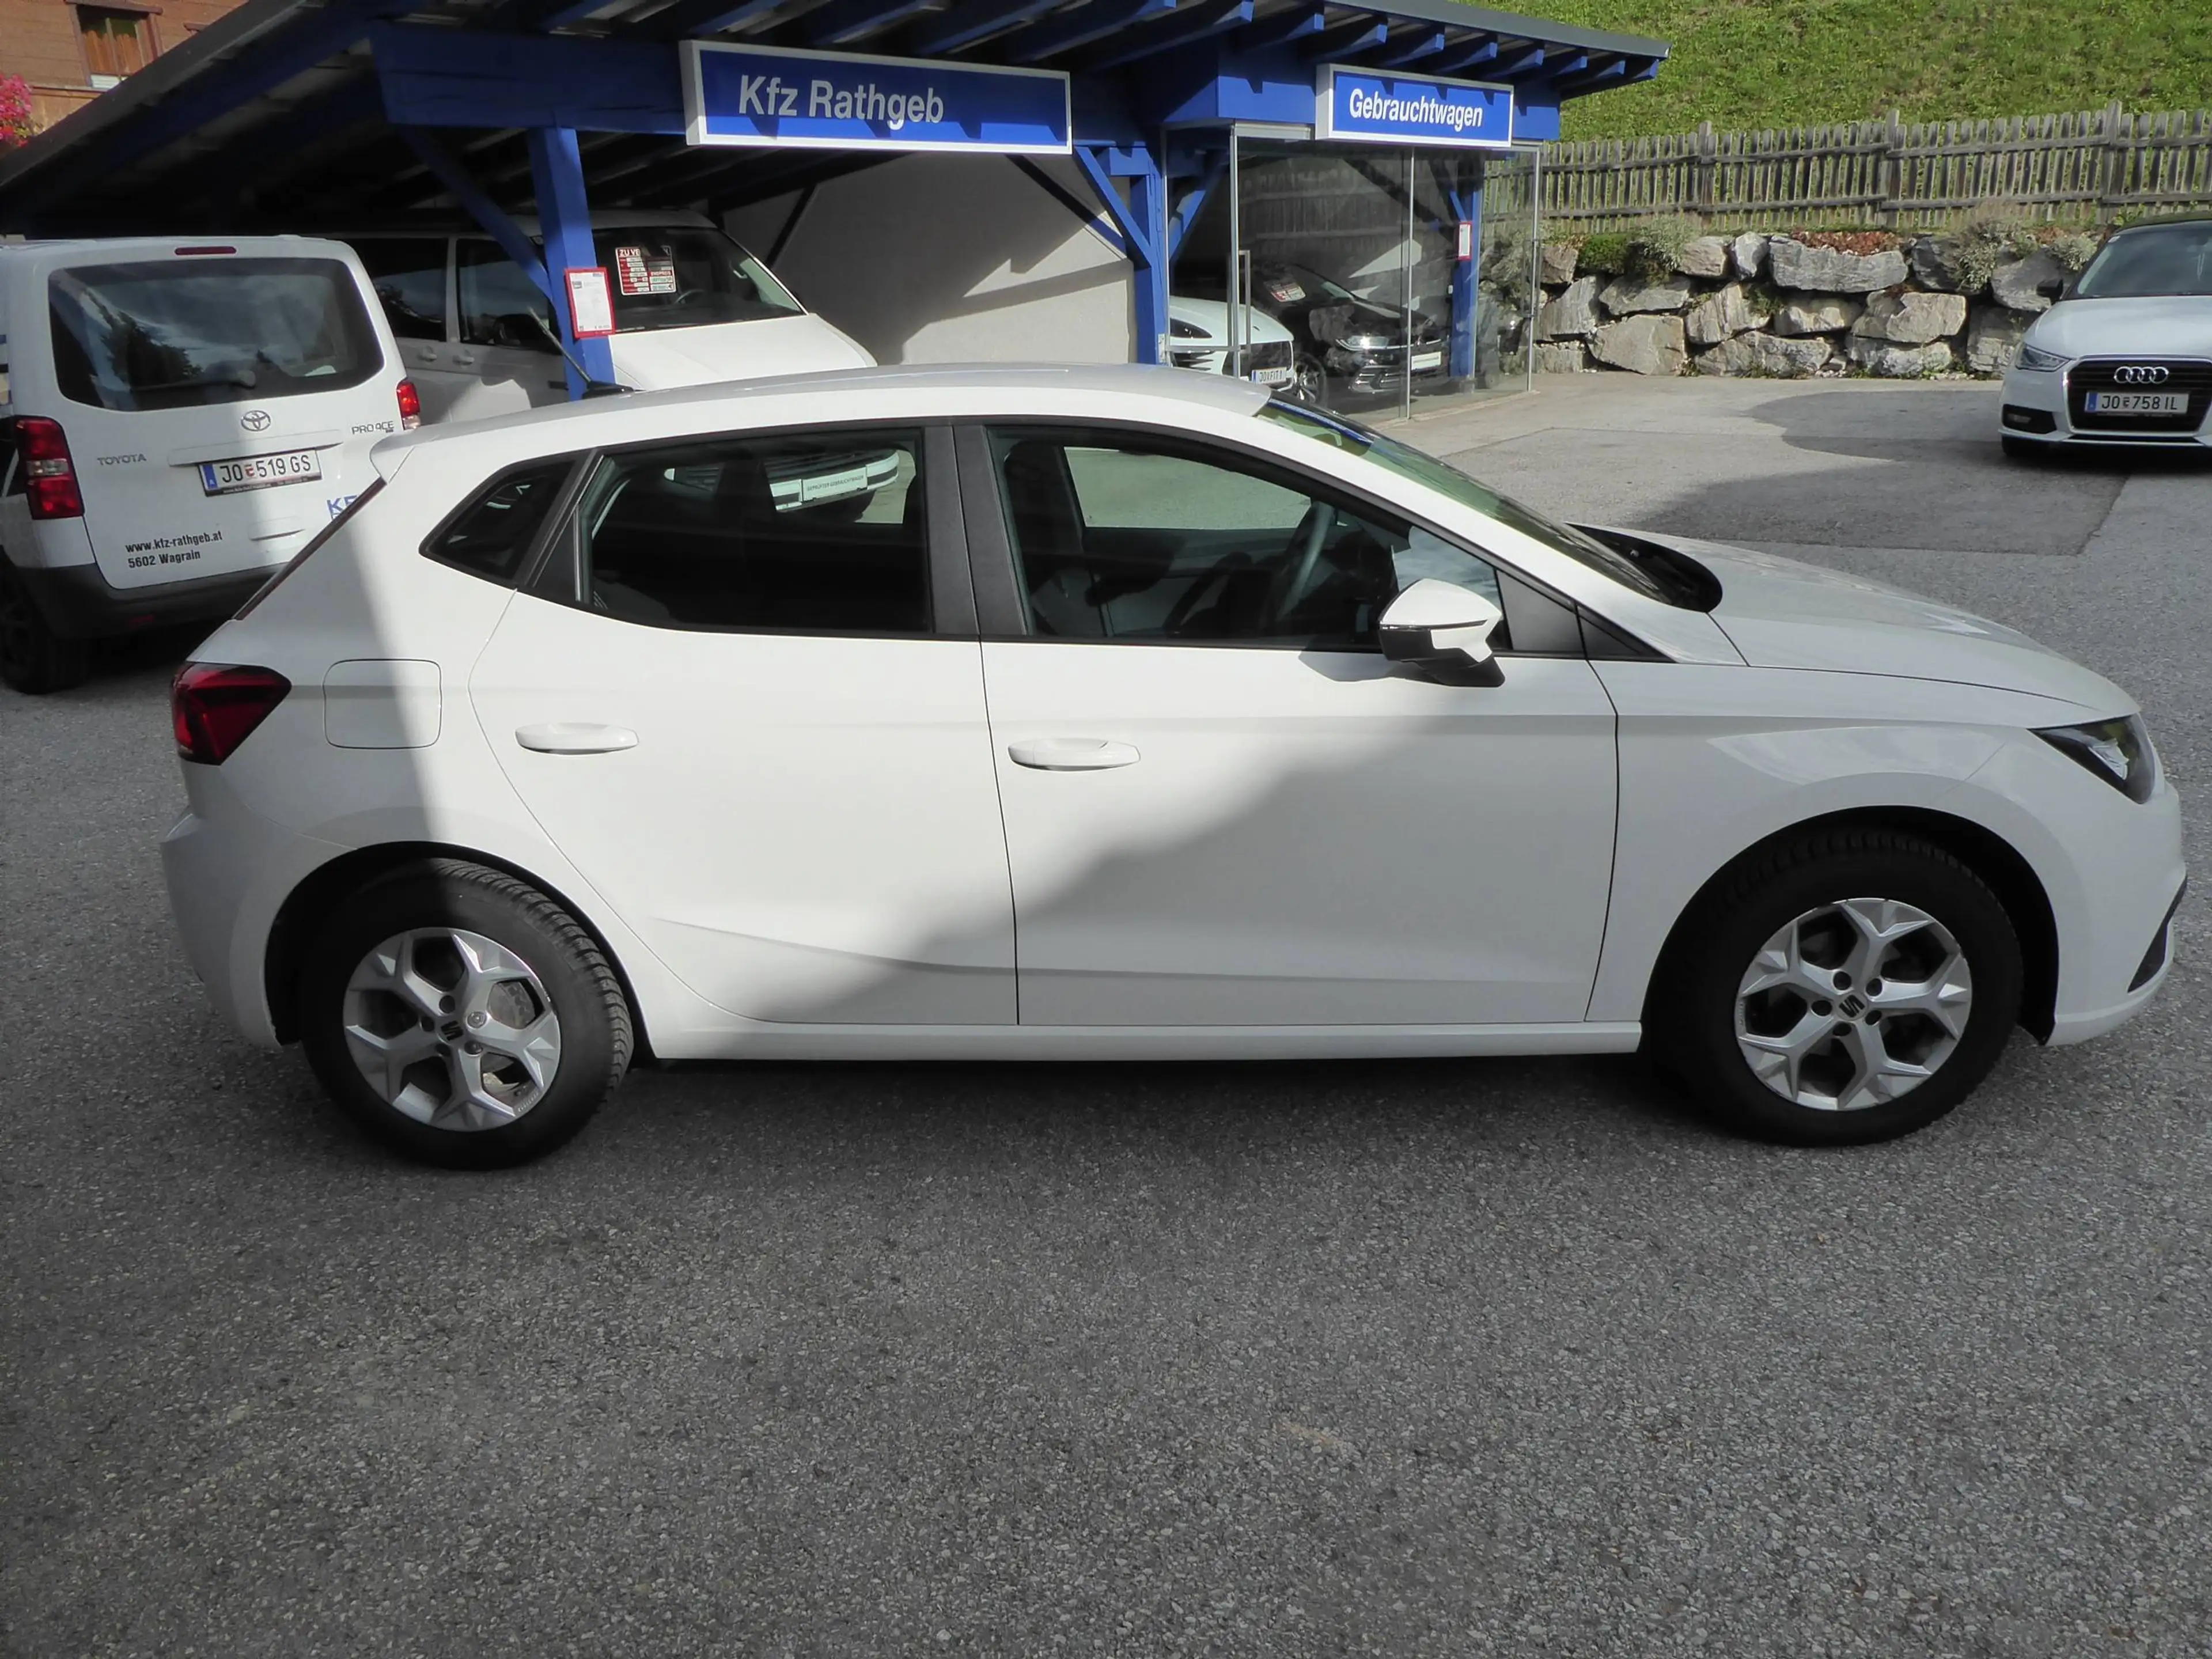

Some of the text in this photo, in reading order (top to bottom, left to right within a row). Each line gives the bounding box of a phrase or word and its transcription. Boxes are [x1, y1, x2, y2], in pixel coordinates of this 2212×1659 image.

[738, 74, 944, 131] Kfz Rathgeb
[1349, 88, 1483, 132] Gebrauchtwagen
[2102, 395, 2177, 410] JO 758 IL
[97, 453, 147, 465] TOYOTA
[219, 464, 243, 483] JO
[256, 458, 286, 478] 519
[290, 455, 310, 473] GS
[327, 495, 358, 513] KF
[125, 531, 222, 553] www.kfz-rathgeb.at
[128, 550, 200, 568] 5602 Wagrain
